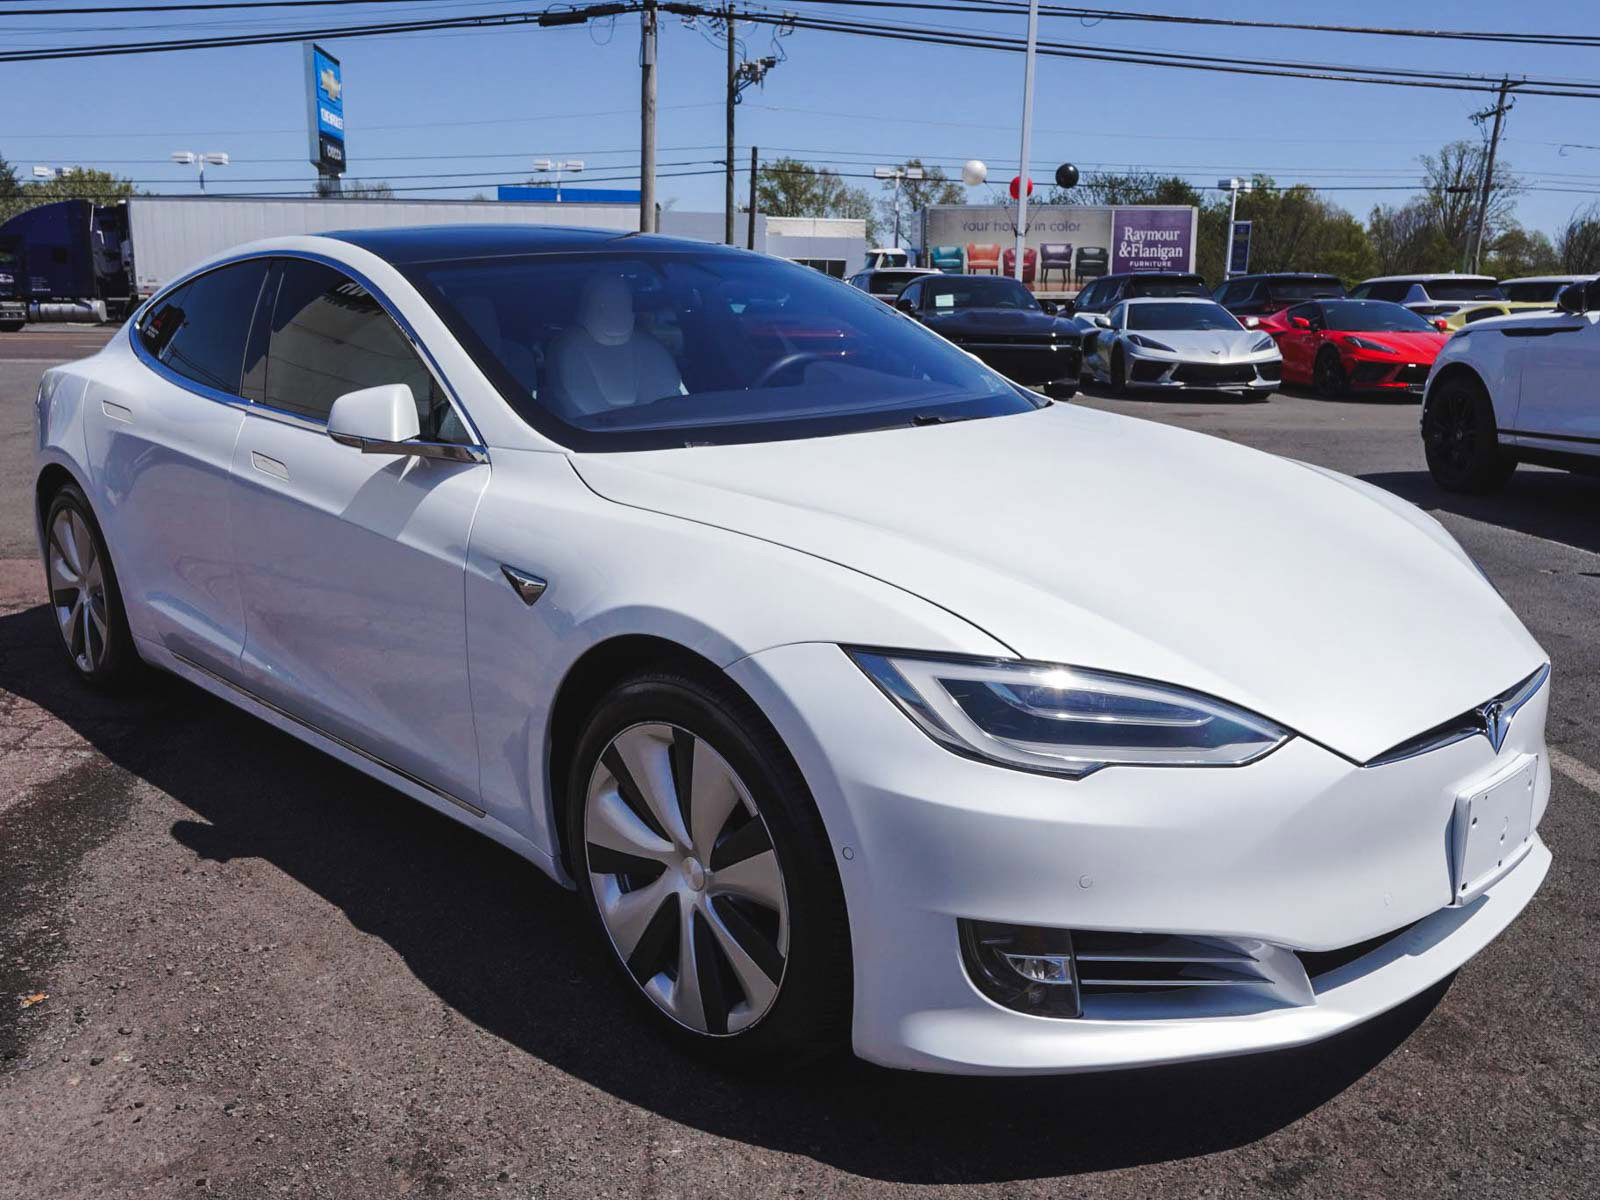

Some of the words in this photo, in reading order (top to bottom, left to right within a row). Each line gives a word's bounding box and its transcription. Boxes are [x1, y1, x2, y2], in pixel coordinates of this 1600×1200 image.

[1035, 221, 1046, 232] in
[1049, 220, 1081, 232] color
[1124, 226, 1180, 242] Raymour
